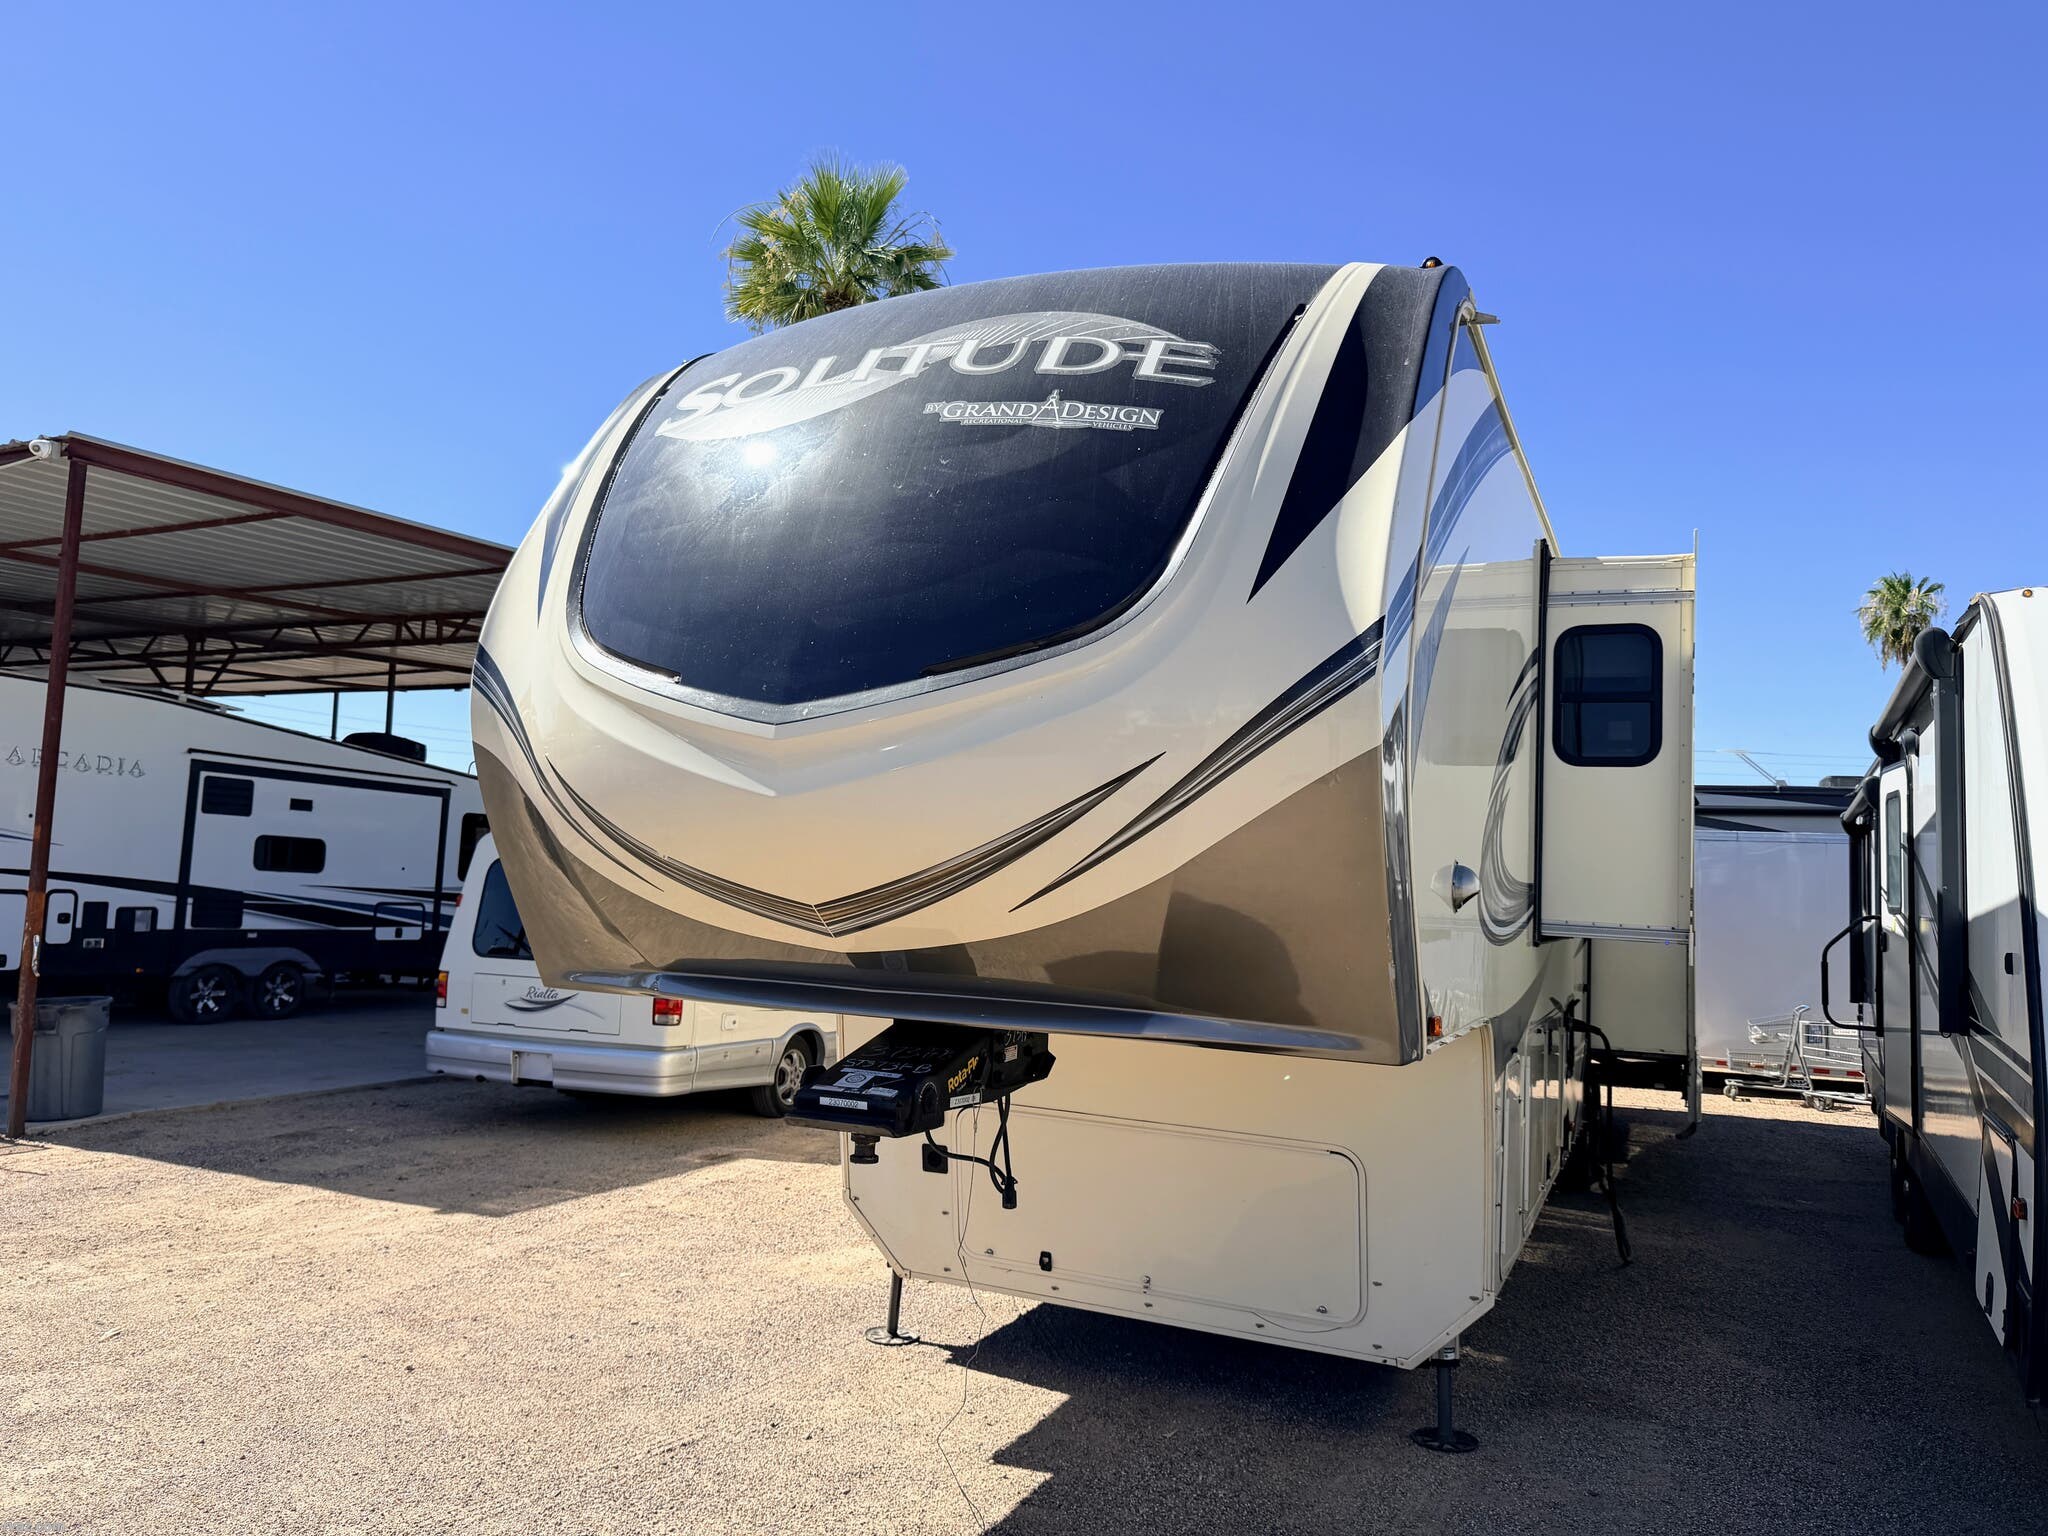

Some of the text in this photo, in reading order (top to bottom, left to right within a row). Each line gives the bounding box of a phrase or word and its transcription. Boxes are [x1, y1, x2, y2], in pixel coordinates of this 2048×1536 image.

[655, 336, 1220, 436] SOLITUDE
[926, 401, 1161, 424] BY GRAND DESIGN
[963, 417, 1134, 431] RECREATIONAL VEHICLES
[526, 985, 559, 999] Rialta
[948, 1056, 979, 1093] Rota-Fl
